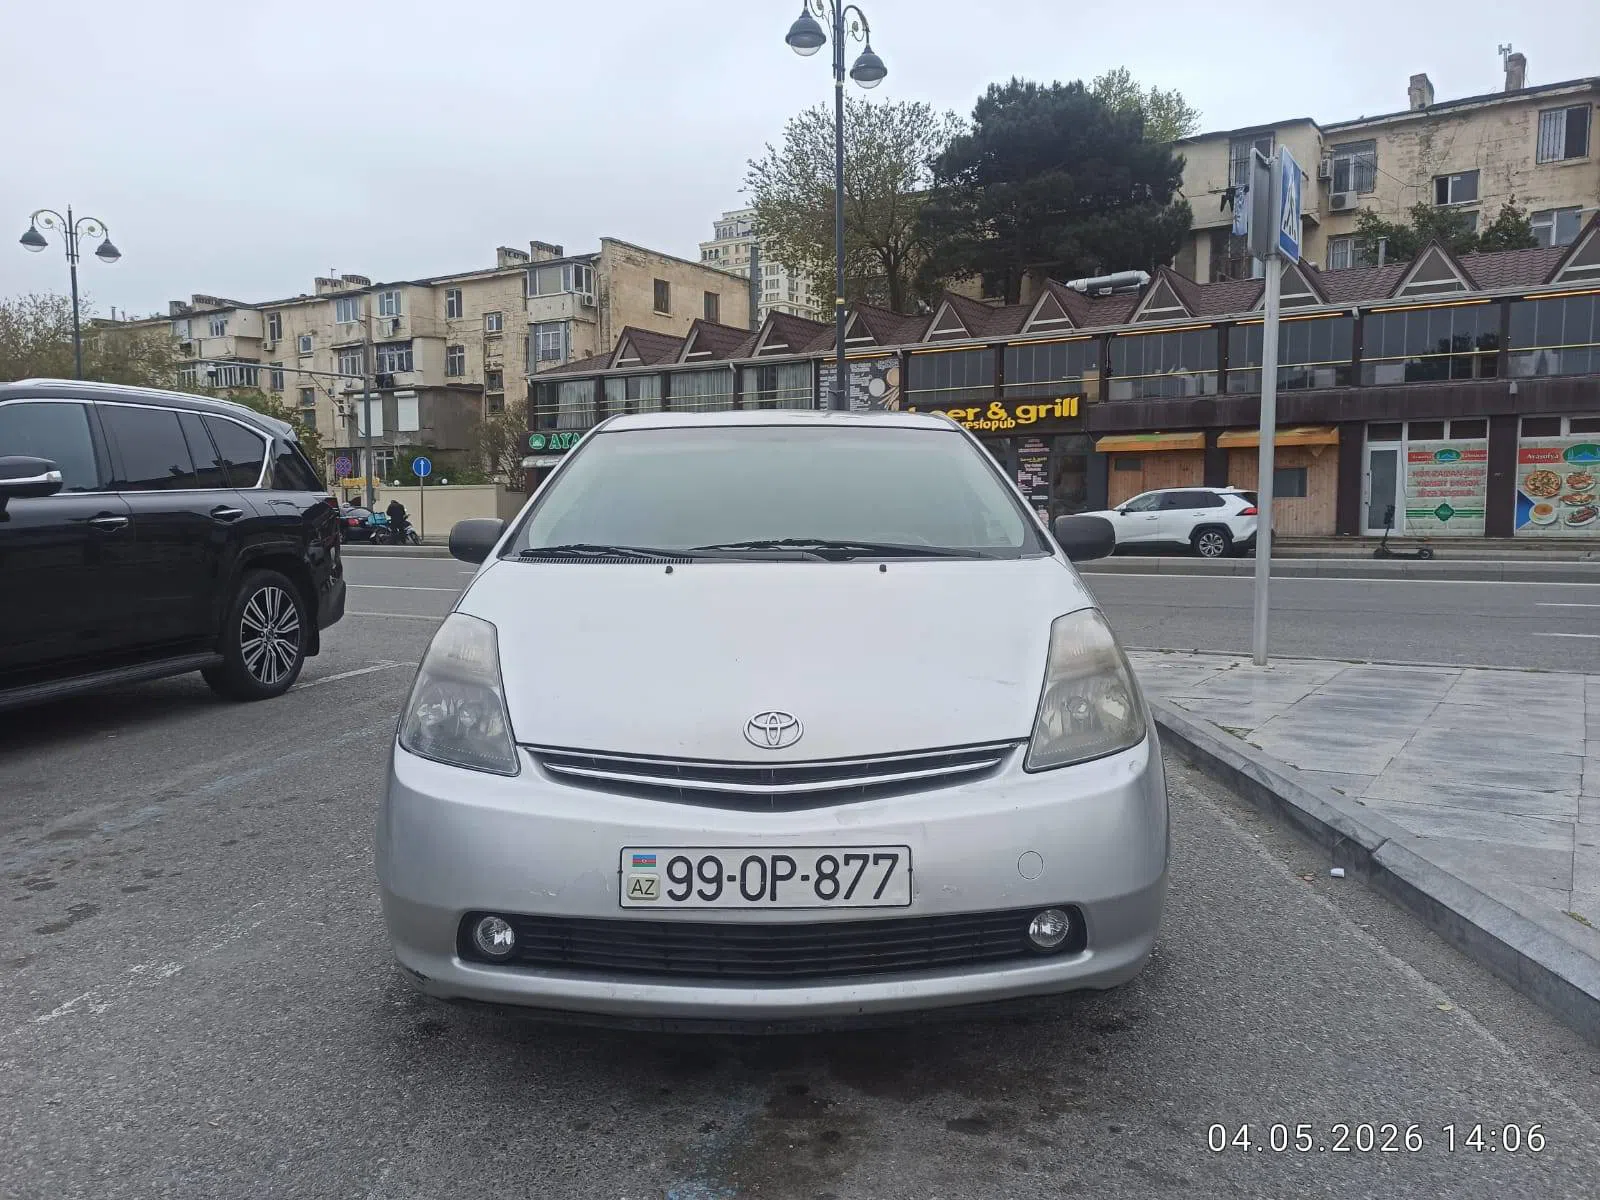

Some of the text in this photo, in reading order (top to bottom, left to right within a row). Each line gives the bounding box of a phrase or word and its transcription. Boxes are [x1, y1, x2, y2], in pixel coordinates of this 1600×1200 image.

[987, 401, 1008, 421] &
[1015, 396, 1080, 424] grill
[630, 878, 655, 896] AZ
[666, 853, 899, 901] 99-OP-877
